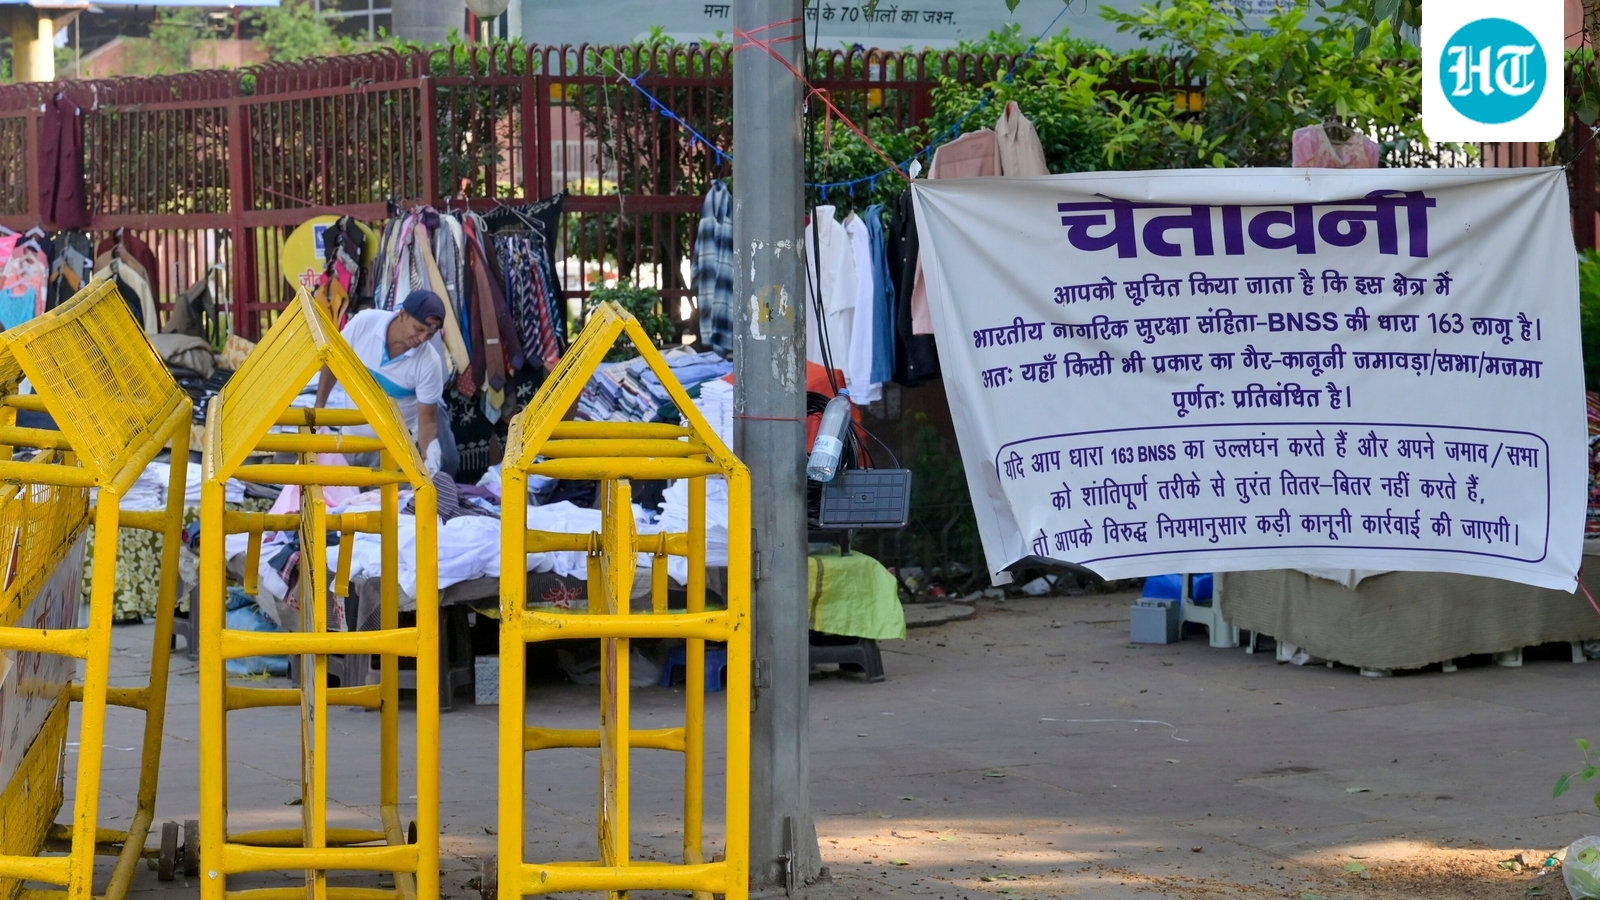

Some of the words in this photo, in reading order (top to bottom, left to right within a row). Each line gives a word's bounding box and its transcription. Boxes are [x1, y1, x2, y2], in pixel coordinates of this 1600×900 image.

[822, 2, 836, 21] के
[840, 6, 859, 22] 70
[901, 9, 919, 24] का
[1053, 275, 1118, 305] आपको
[1122, 272, 1183, 307] सूचित
[1187, 271, 1240, 297] किया
[1244, 276, 1296, 295] जाता
[1297, 268, 1316, 297] है
[1320, 269, 1349, 294] कि
[1353, 275, 1386, 296] इस
[1392, 272, 1428, 297] क्षेत्र
[1432, 269, 1454, 297] में
[972, 316, 1046, 349] भारतीय
[1050, 314, 1130, 341] नागरिक
[1133, 316, 1191, 345] सुरक्षा
[1343, 306, 1371, 332] की
[1377, 314, 1420, 333] धारा
[1427, 312, 1465, 334] 163
[1469, 317, 1514, 346] लागू
[1019, 352, 1058, 384] यहाँ
[1062, 350, 1115, 379] किसी
[1121, 349, 1147, 374] भी
[1151, 353, 1204, 375] प्रकार
[1208, 352, 1236, 371] का
[1231, 381, 1323, 409] प्रतिबंधित
[1003, 450, 1026, 481] यदि
[1031, 450, 1061, 473] आप
[1068, 446, 1104, 468] धारा
[1110, 446, 1135, 465] 163
[1137, 443, 1177, 463] BNSS
[1182, 439, 1206, 460] का
[1286, 429, 1326, 457] करते
[1333, 429, 1348, 459] हैं
[1357, 429, 1389, 458] और
[1396, 431, 1435, 460] अपने
[1049, 481, 1072, 511] को
[1080, 473, 1149, 511] शांतिपूर्ण
[1156, 470, 1201, 500] तरीके
[1209, 469, 1226, 498] से
[1234, 471, 1272, 504] तुरंत
[1379, 470, 1410, 499] नहीं
[1418, 472, 1457, 500] करते
[1032, 528, 1050, 557] तो
[1054, 518, 1093, 552] आपके
[1101, 516, 1148, 544] विरुद्ध
[1155, 512, 1248, 544] नियमानुसार
[1254, 507, 1292, 537] कड़ी
[1299, 507, 1353, 541] कानूनी
[1360, 507, 1421, 540] कार्रवाई
[1429, 511, 1453, 537] की
